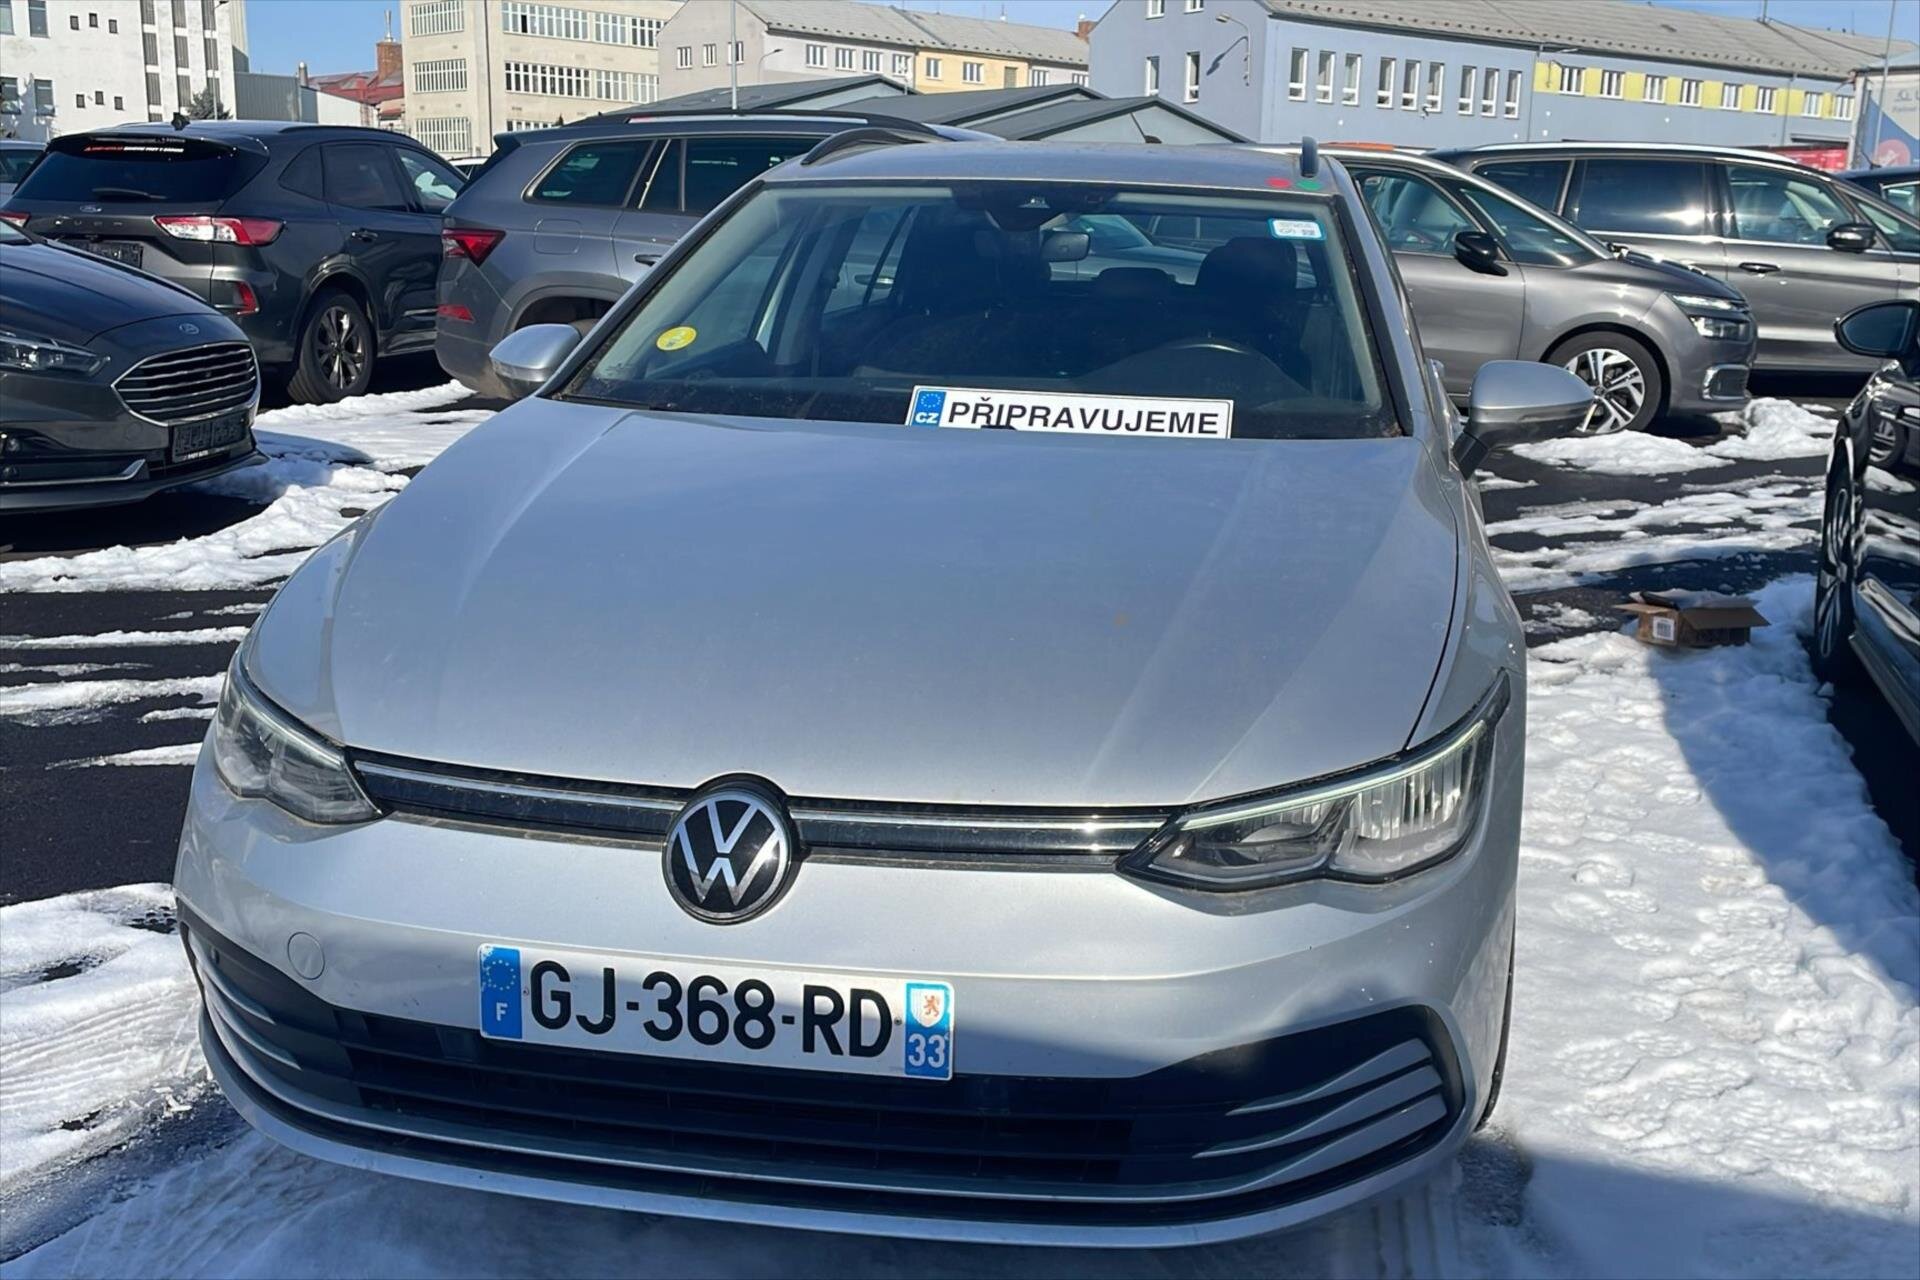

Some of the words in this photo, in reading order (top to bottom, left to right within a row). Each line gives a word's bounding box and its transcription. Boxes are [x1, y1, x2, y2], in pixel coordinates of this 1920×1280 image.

[915, 411, 939, 424] CZ
[948, 396, 1219, 435] PŘIPRAVUJEME
[677, 799, 780, 906] VW
[495, 1002, 508, 1021] F
[529, 960, 893, 1058] GJ-368-RD
[907, 1032, 947, 1069] 33
